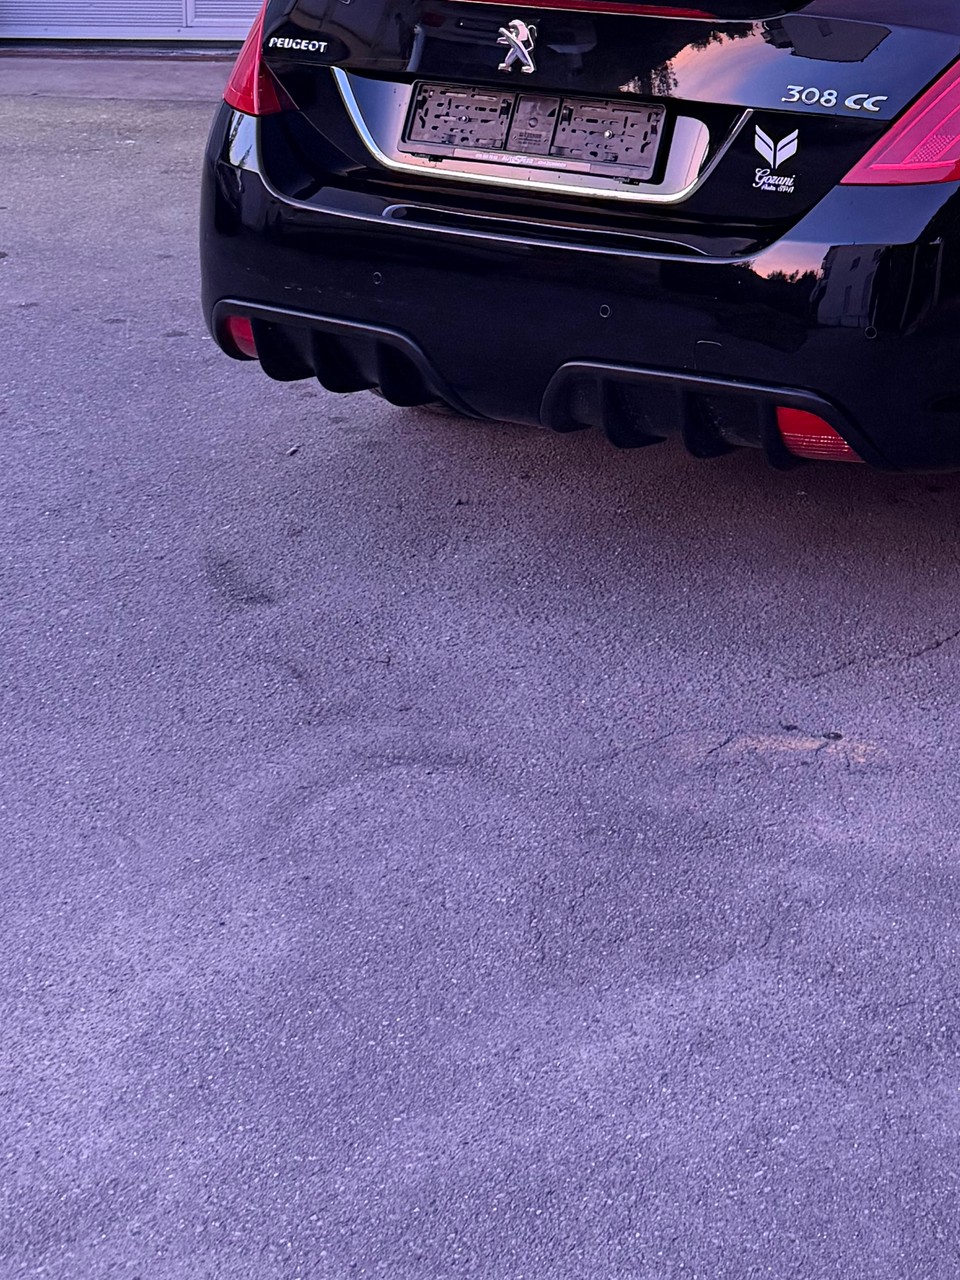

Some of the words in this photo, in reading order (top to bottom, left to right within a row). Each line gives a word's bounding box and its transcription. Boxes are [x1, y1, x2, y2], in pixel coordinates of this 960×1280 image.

[268, 37, 328, 53] PEUGEOT
[781, 84, 838, 108] 308
[844, 93, 888, 112] CC
